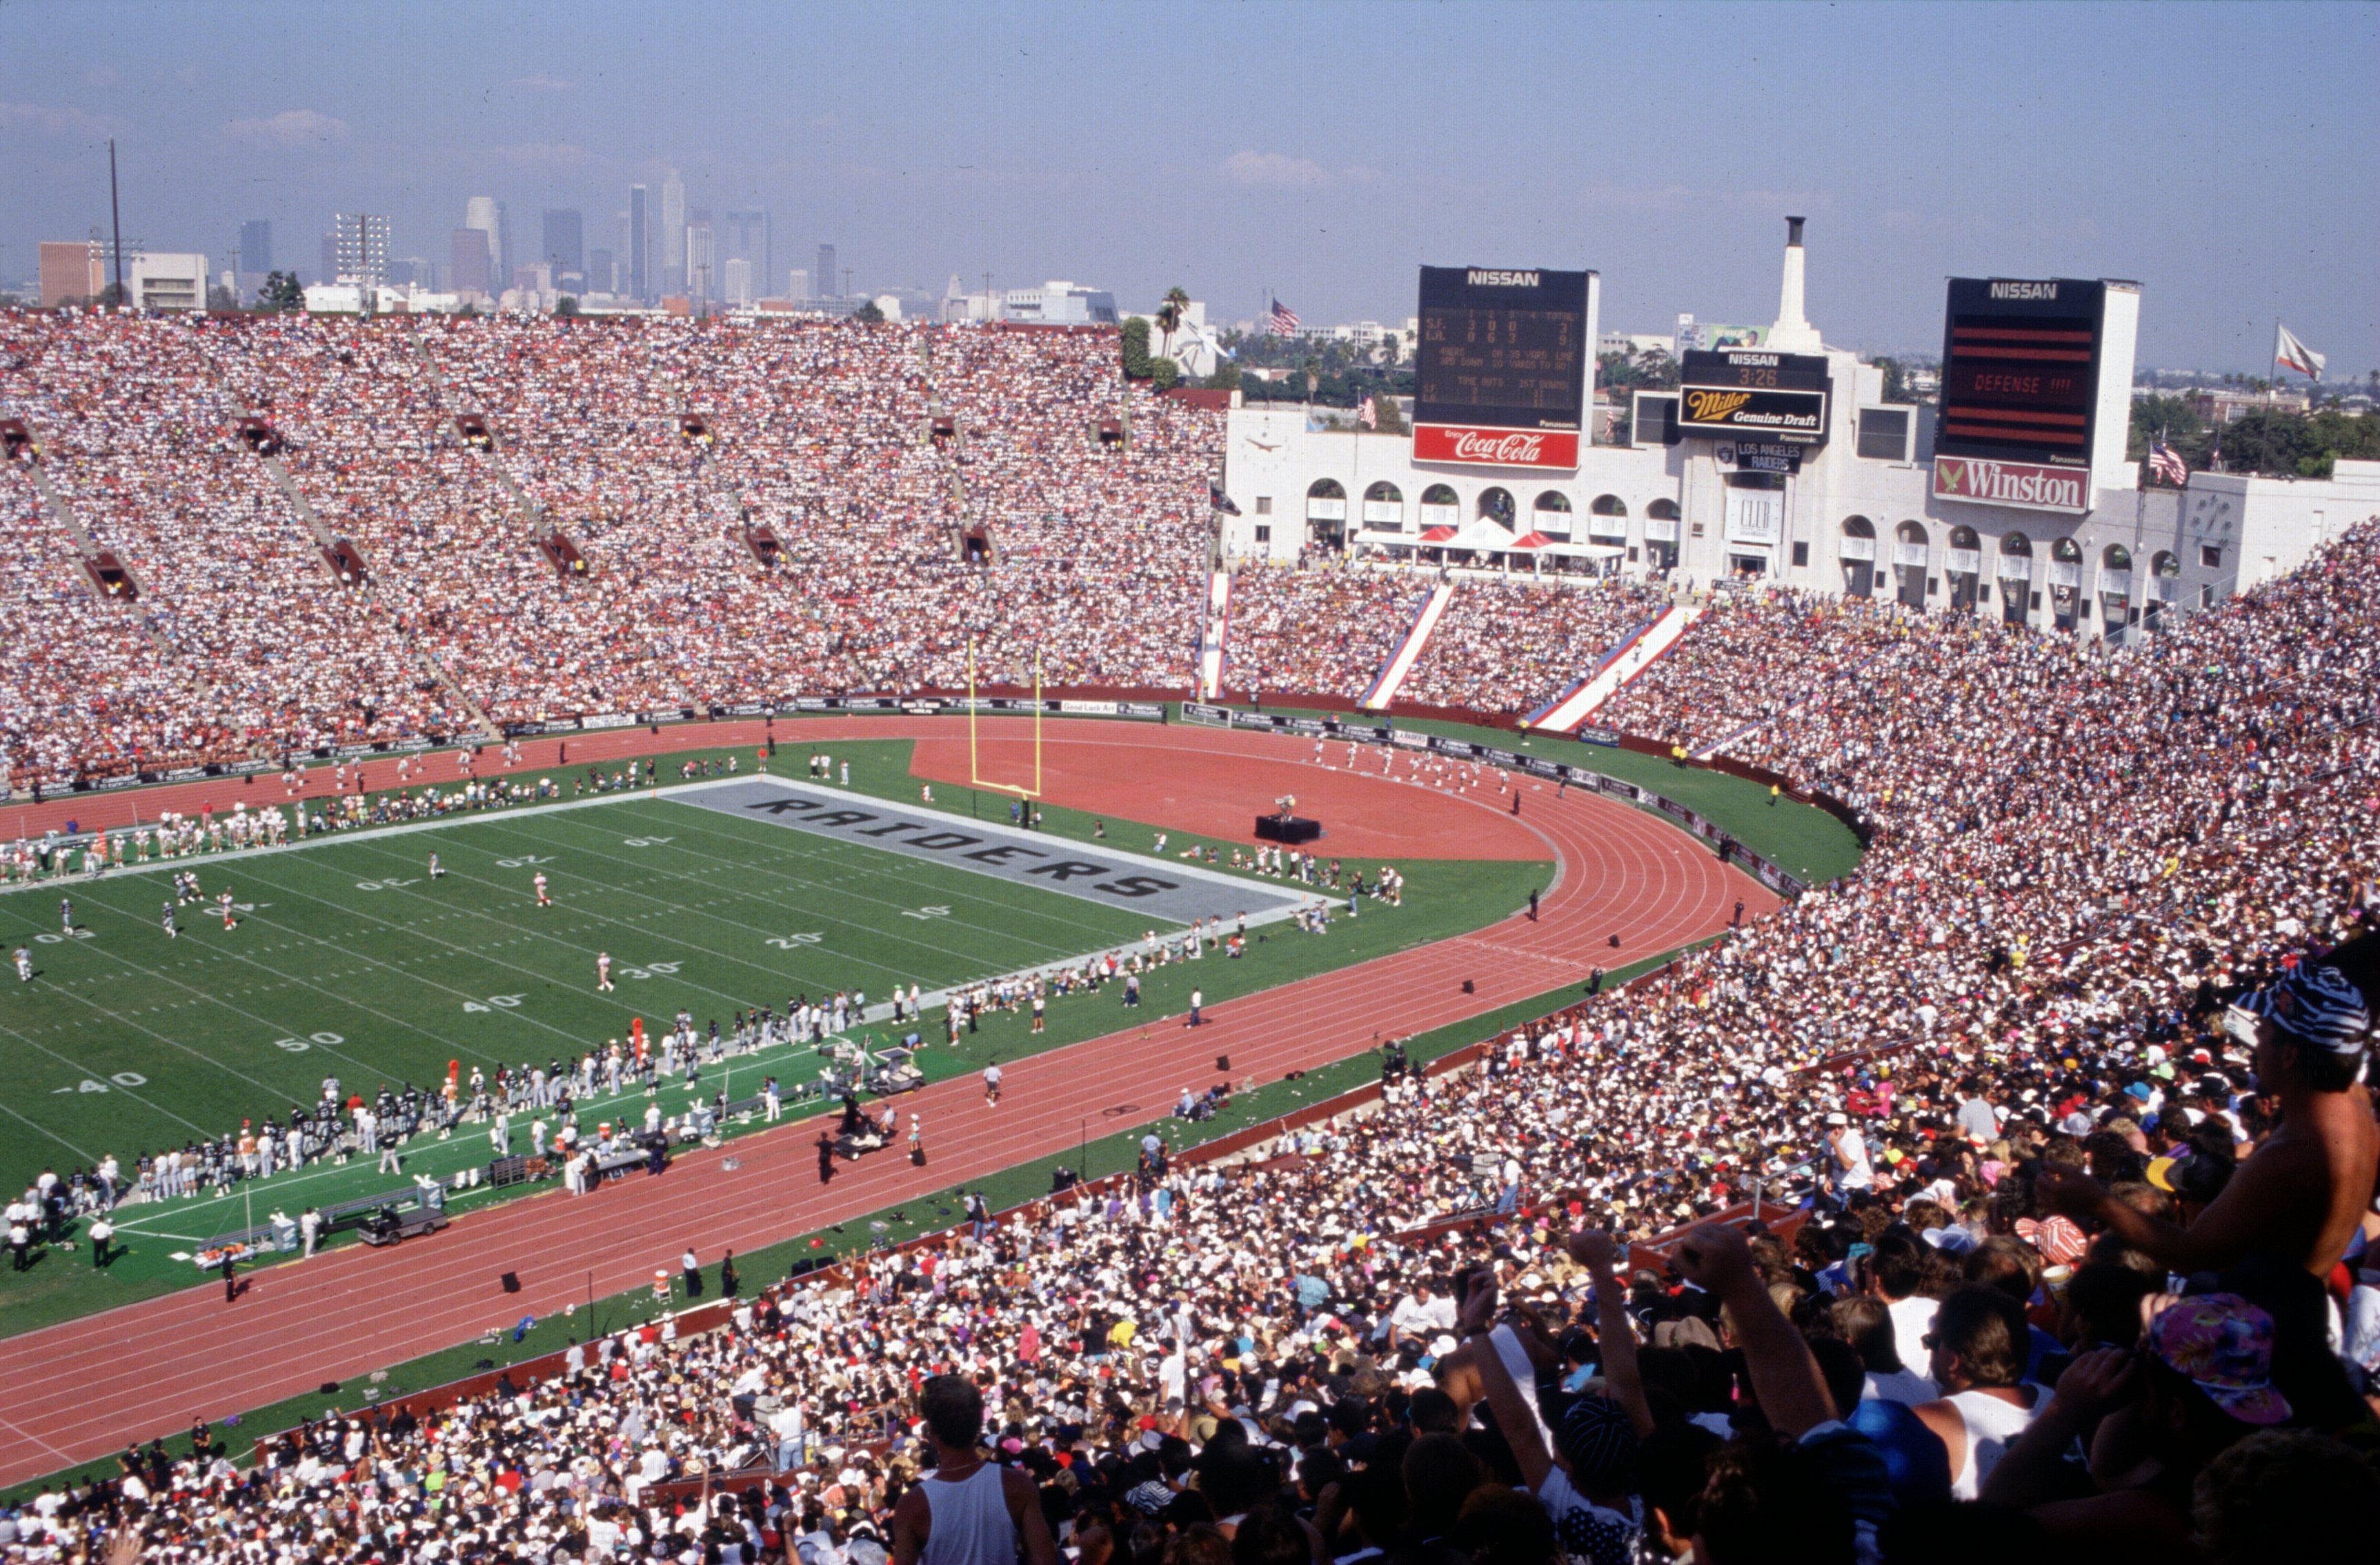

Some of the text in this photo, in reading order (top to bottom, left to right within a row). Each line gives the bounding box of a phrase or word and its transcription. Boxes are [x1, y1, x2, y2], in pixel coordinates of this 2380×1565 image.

[1467, 271, 1539, 286] NISSAN
[1991, 282, 2057, 299] NISSAN
[1729, 353, 1778, 366] NISSAN
[1739, 368, 1777, 386] 3:26
[1974, 374, 2039, 394] DEFENSE
[1687, 390, 1753, 420] Miller
[1539, 419, 1578, 429] Panasonic
[1734, 411, 1816, 426] Genuine Draft
[1445, 430, 1463, 440] Enjoy
[1780, 433, 1817, 443] Panasonic
[1738, 443, 1801, 458] LOS ANGELES
[1752, 456, 1789, 470] RAIDERS
[2050, 455, 2087, 464] Panasonic
[1966, 461, 2081, 507] Winston
[1064, 701, 1115, 712] Good Luck Art
[745, 799, 1180, 898] RAIDERS
[356, 877, 411, 891] 30
[902, 906, 951, 920] 10
[766, 932, 823, 950] 20
[619, 962, 680, 979] 30
[462, 995, 523, 1013] 40
[275, 1032, 345, 1052] 50
[78, 1072, 148, 1094] 40
